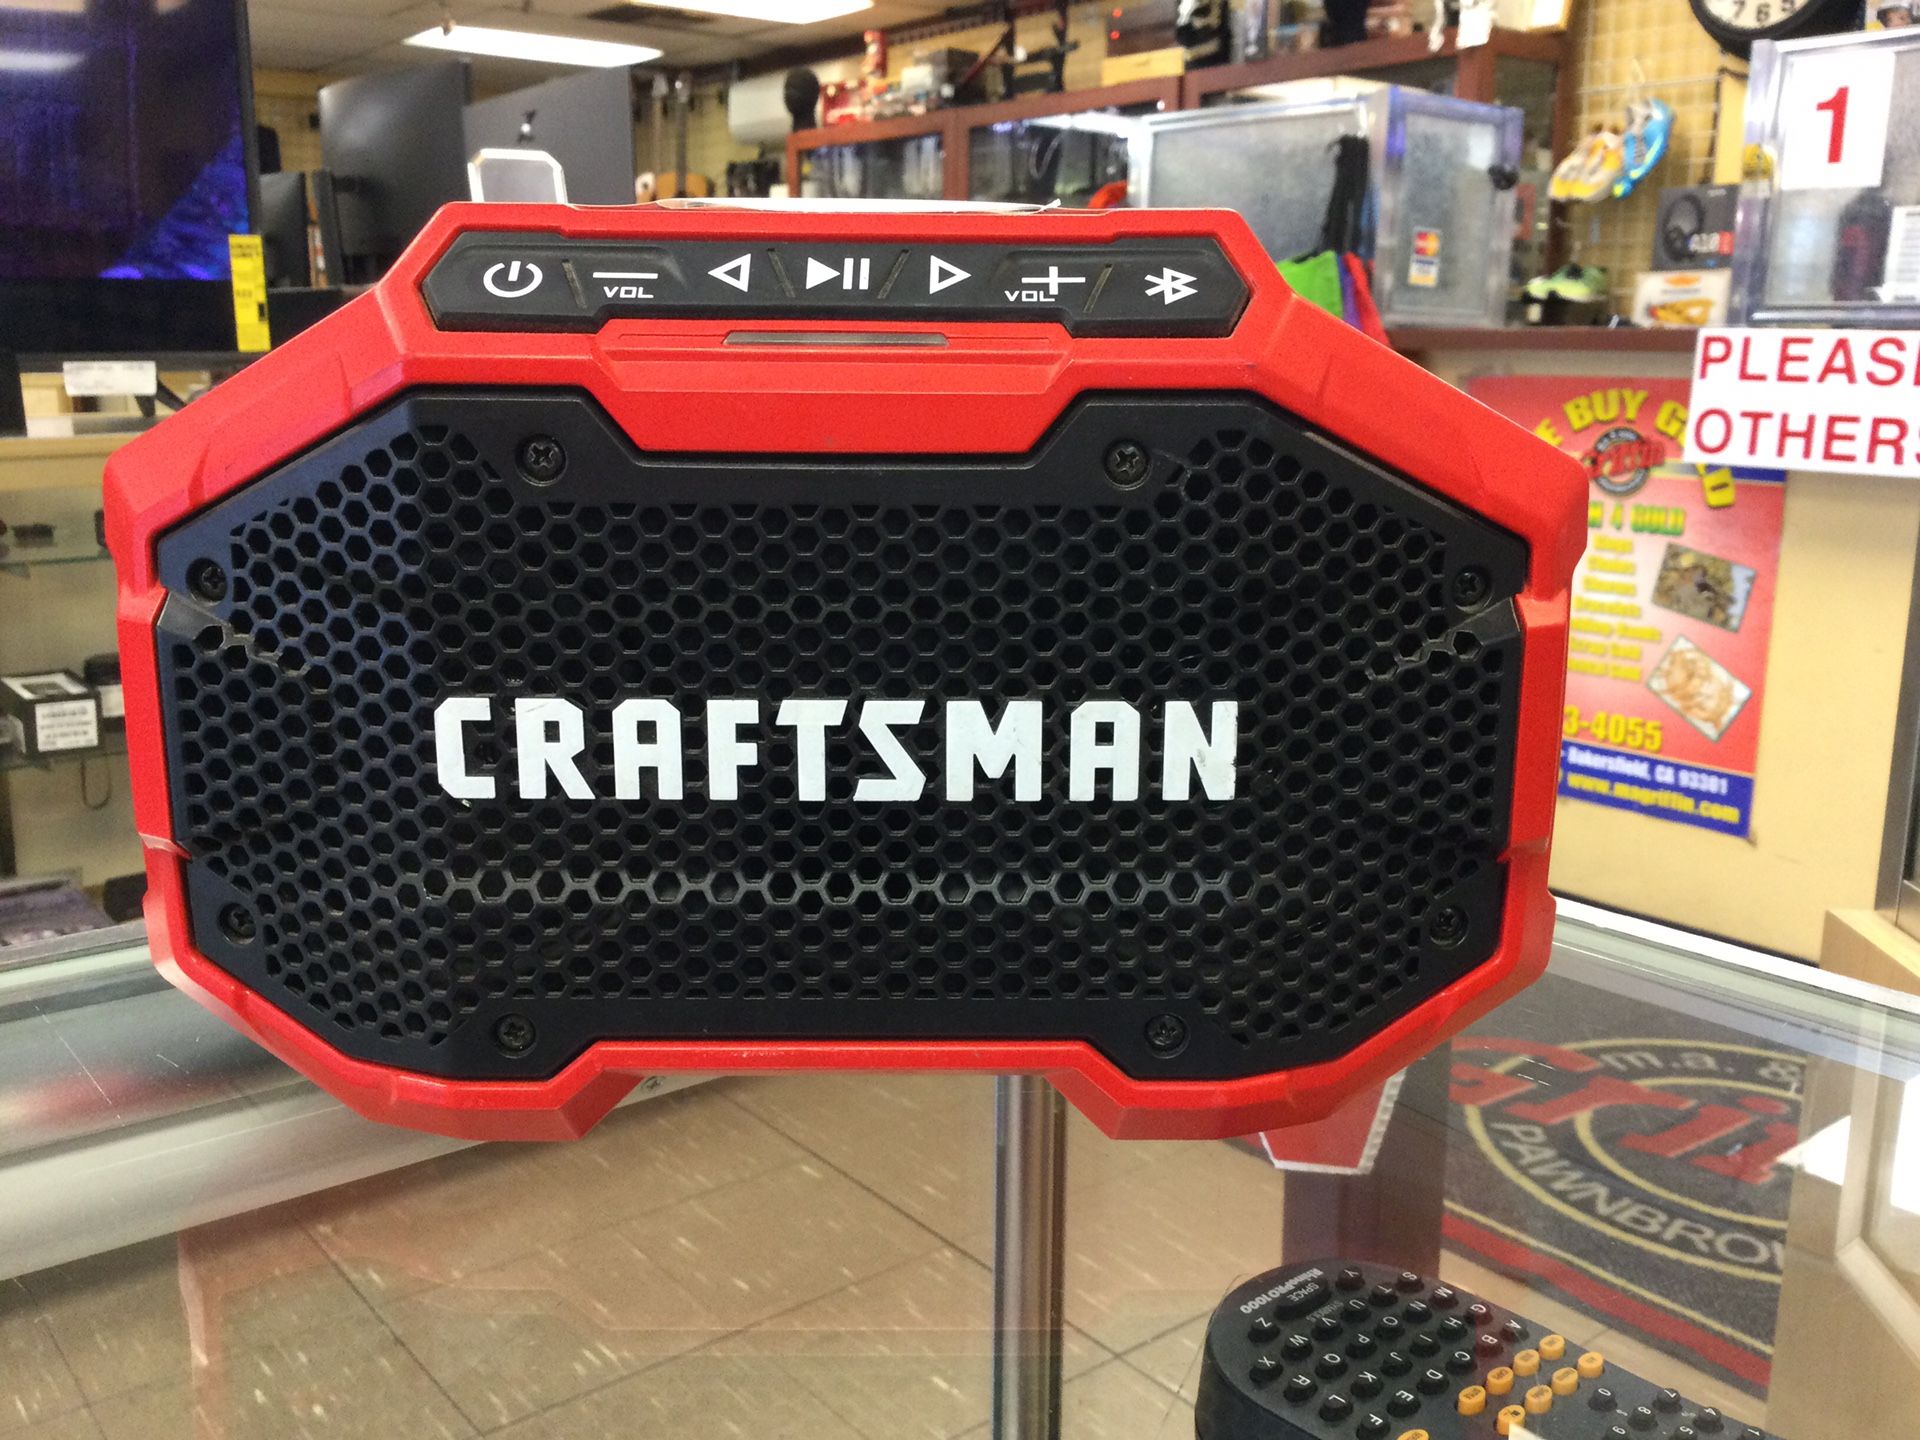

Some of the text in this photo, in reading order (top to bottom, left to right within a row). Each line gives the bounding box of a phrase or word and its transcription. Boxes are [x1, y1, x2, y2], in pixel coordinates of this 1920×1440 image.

[1756, 3, 1770, 22] 6
[1817, 86, 1850, 164] 1
[603, 286, 654, 298] VOL
[1004, 290, 1055, 302] VOL
[1699, 335, 1920, 386] PLEAS
[1563, 387, 1648, 432] BUY
[1694, 408, 1920, 465] OTHER
[434, 696, 1239, 803] CRAFTSMAN
[1286, 1283, 1320, 1302] SPACE
